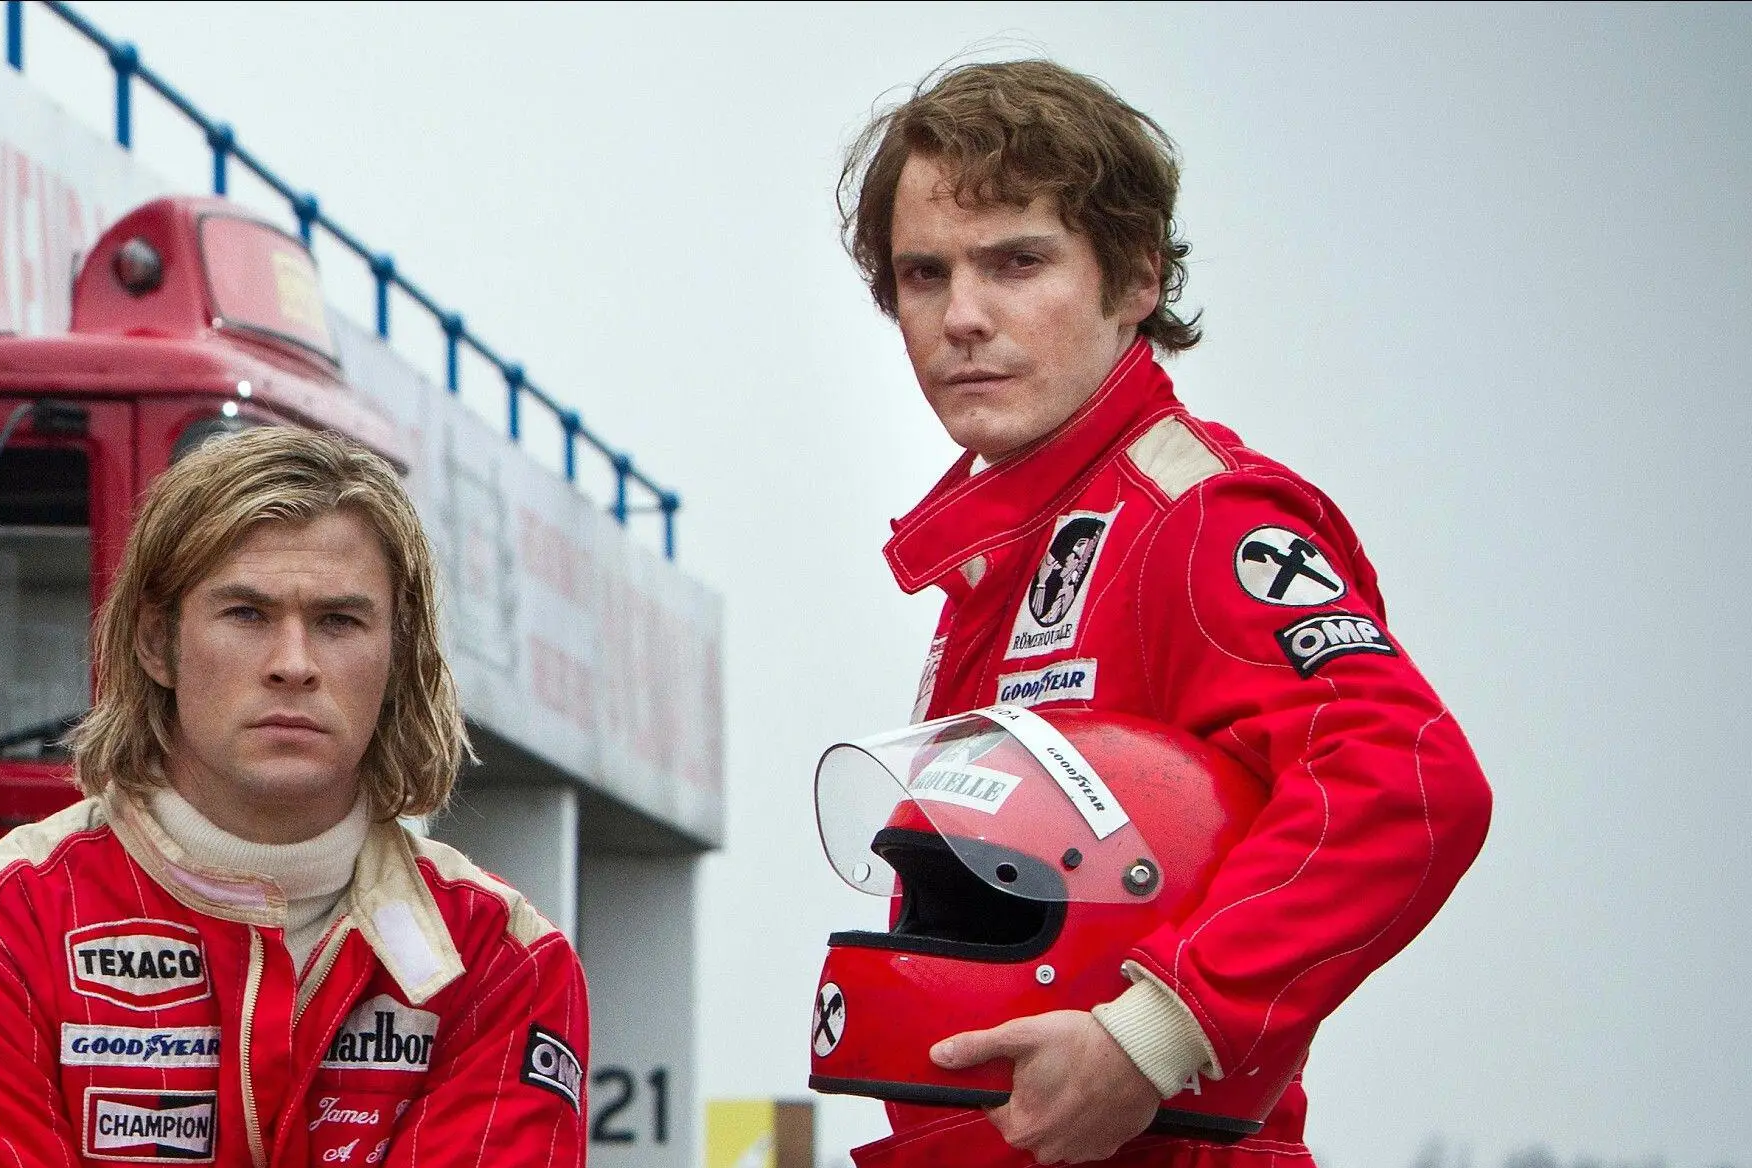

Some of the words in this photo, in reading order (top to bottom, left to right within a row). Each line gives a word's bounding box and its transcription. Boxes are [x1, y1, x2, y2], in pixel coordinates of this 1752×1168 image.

[1291, 620, 1380, 658] OMP
[1000, 669, 1086, 702] GOODYEAR
[1047, 747, 1106, 812] GOODYEAR
[78, 948, 201, 979] TEXACO
[71, 1034, 220, 1061] GOODYEAR
[532, 1043, 581, 1101] OM
[309, 1097, 381, 1131] James
[590, 1066, 667, 1144] 21
[98, 1113, 210, 1140] CHAMPION
